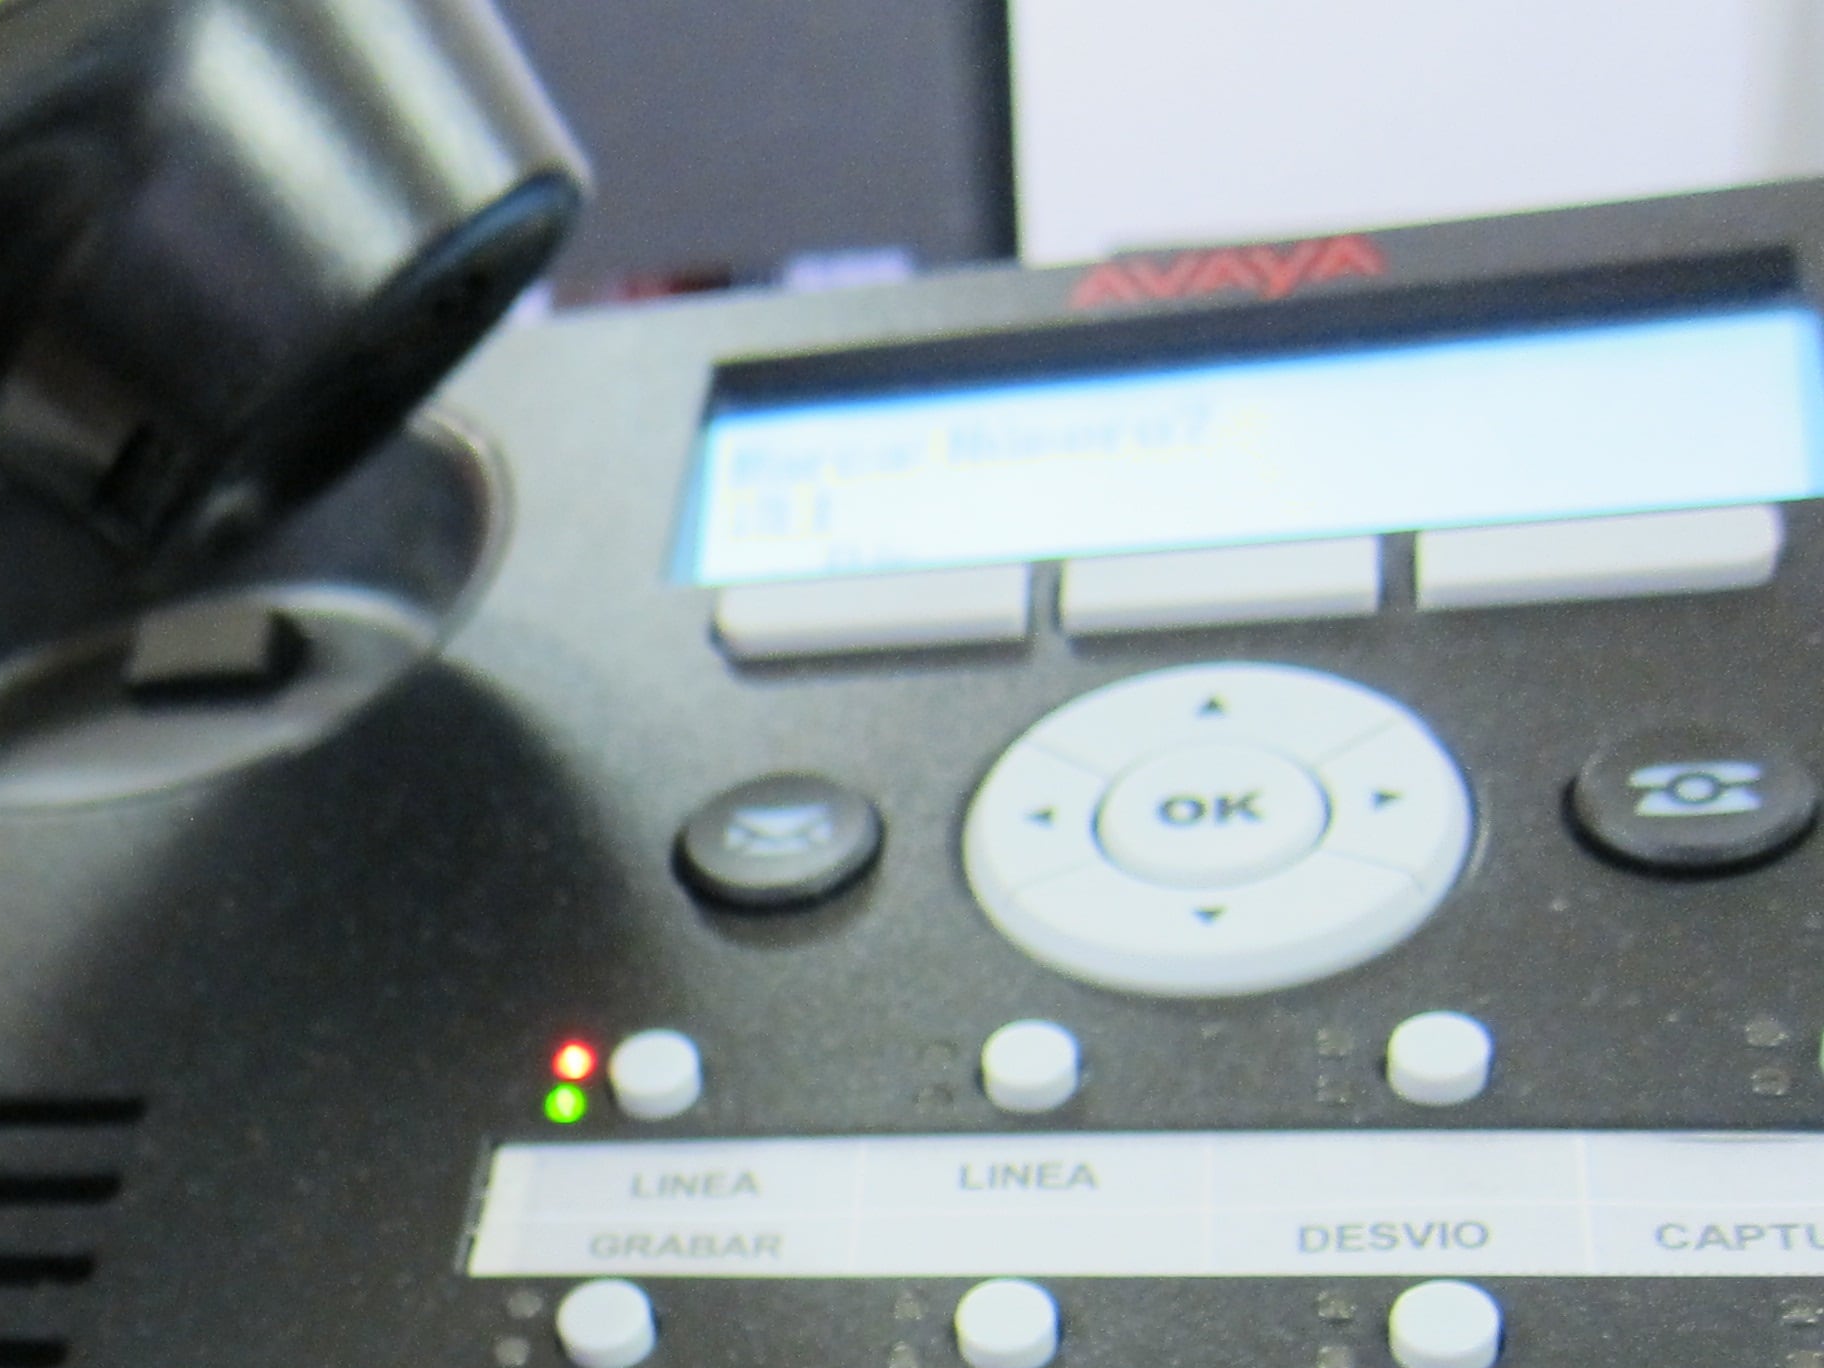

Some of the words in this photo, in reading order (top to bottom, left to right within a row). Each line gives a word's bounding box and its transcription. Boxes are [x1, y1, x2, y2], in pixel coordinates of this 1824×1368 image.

[1067, 233, 1384, 309] AVAYA
[1156, 792, 1260, 826] OK
[629, 1170, 759, 1200] LINEA
[958, 1161, 1098, 1191] LINEA
[587, 1232, 782, 1261] GRABAR
[1297, 1219, 1491, 1254] DESVIO
